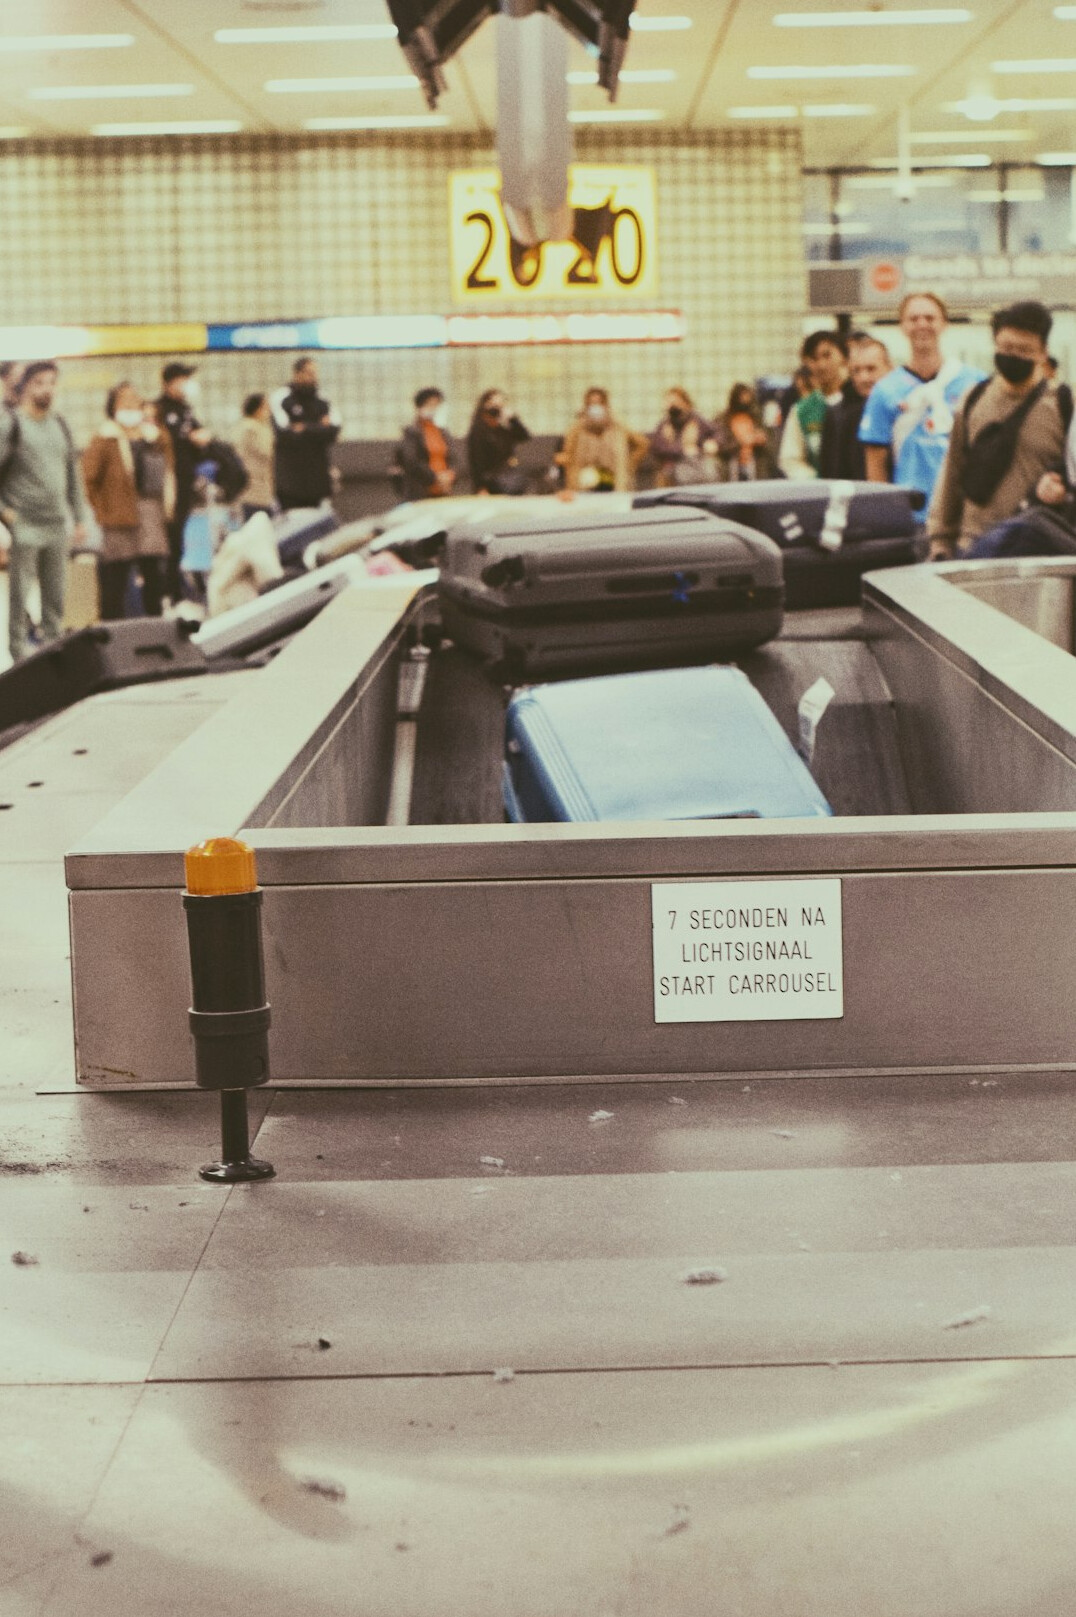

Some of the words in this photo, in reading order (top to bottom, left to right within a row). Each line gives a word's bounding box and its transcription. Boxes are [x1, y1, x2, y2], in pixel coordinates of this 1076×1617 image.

[667, 909, 678, 930] 7
[689, 907, 789, 930] SECONDEN
[801, 906, 827, 927] NA
[682, 940, 814, 963] LICHTSIGNAAL
[659, 975, 716, 996] START
[728, 972, 838, 995] CARROUSEL
